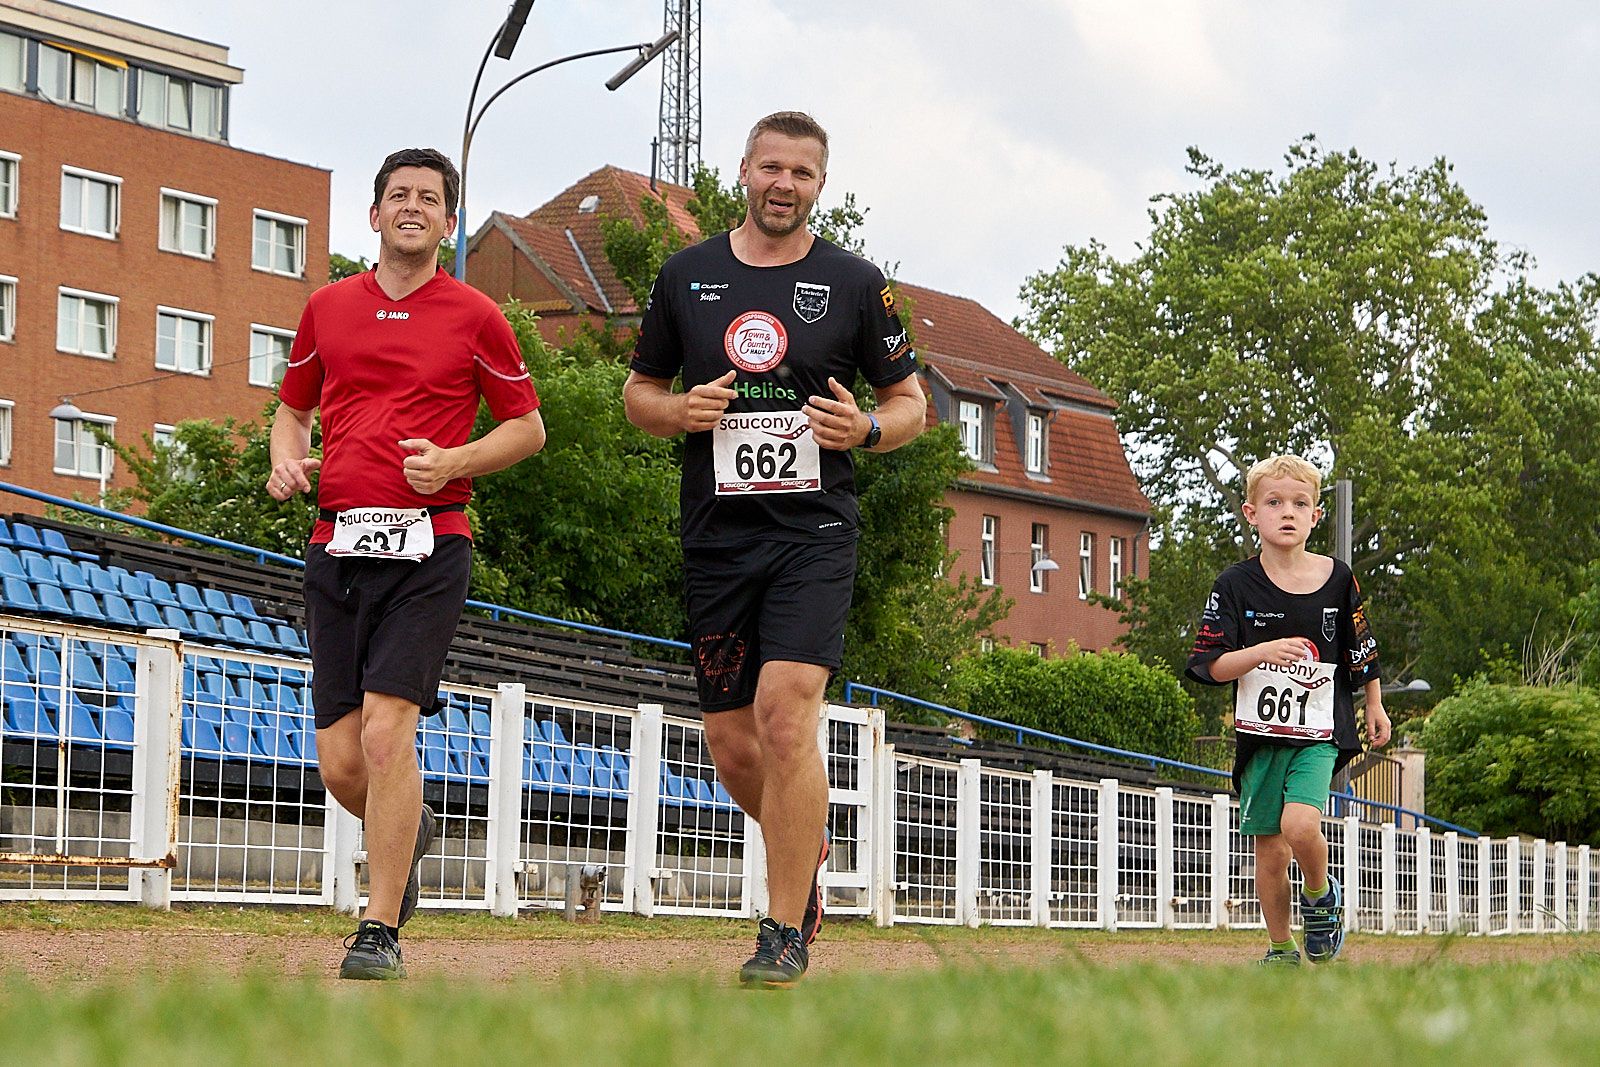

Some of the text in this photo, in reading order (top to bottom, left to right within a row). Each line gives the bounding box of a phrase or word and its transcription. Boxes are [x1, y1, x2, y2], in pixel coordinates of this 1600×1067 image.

[387, 311, 410, 320] JAKO
[739, 328, 770, 341] Town
[739, 338, 774, 355] Country
[749, 348, 766, 356] HAUS
[733, 381, 797, 401] Helios
[719, 416, 796, 431] saucony
[735, 441, 798, 480] 662
[1256, 661, 1318, 680] aucony
[1257, 685, 1311, 726] 661
